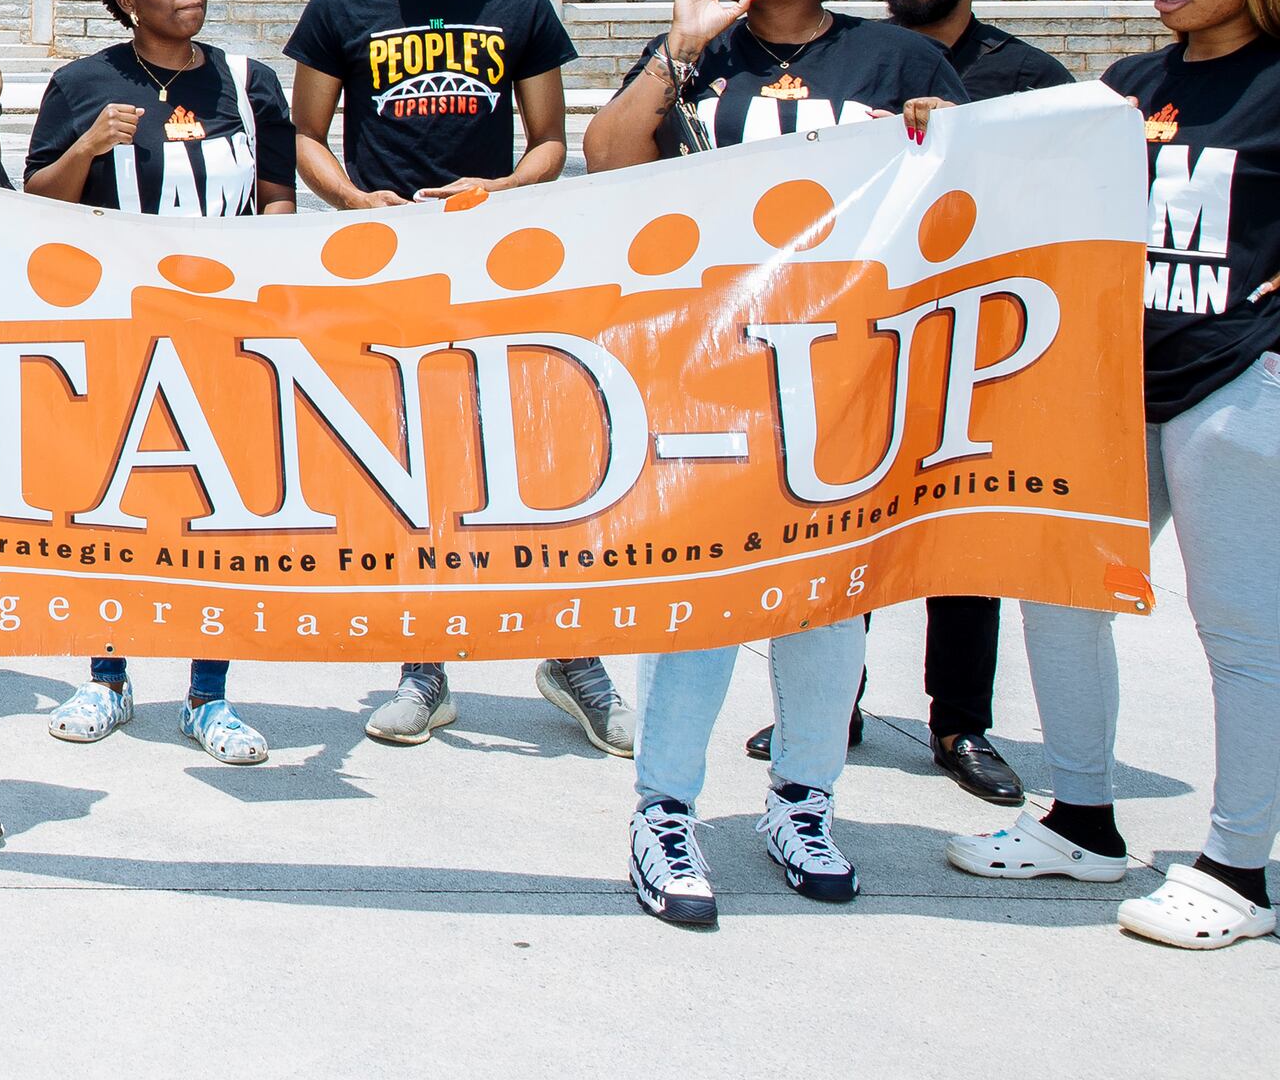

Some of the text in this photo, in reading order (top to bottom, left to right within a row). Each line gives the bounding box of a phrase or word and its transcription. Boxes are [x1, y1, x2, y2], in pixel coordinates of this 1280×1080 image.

[429, 18, 445, 30] THE
[369, 32, 505, 90] PEOPLE'S
[394, 96, 478, 118] UPRISING
[156, 545, 317, 572] Alliance
[339, 548, 396, 571] For
[418, 545, 491, 571] New
[514, 539, 722, 571] Directions
[743, 530, 764, 553] &
[782, 496, 900, 545] Unified
[914, 471, 1071, 506] Policies
